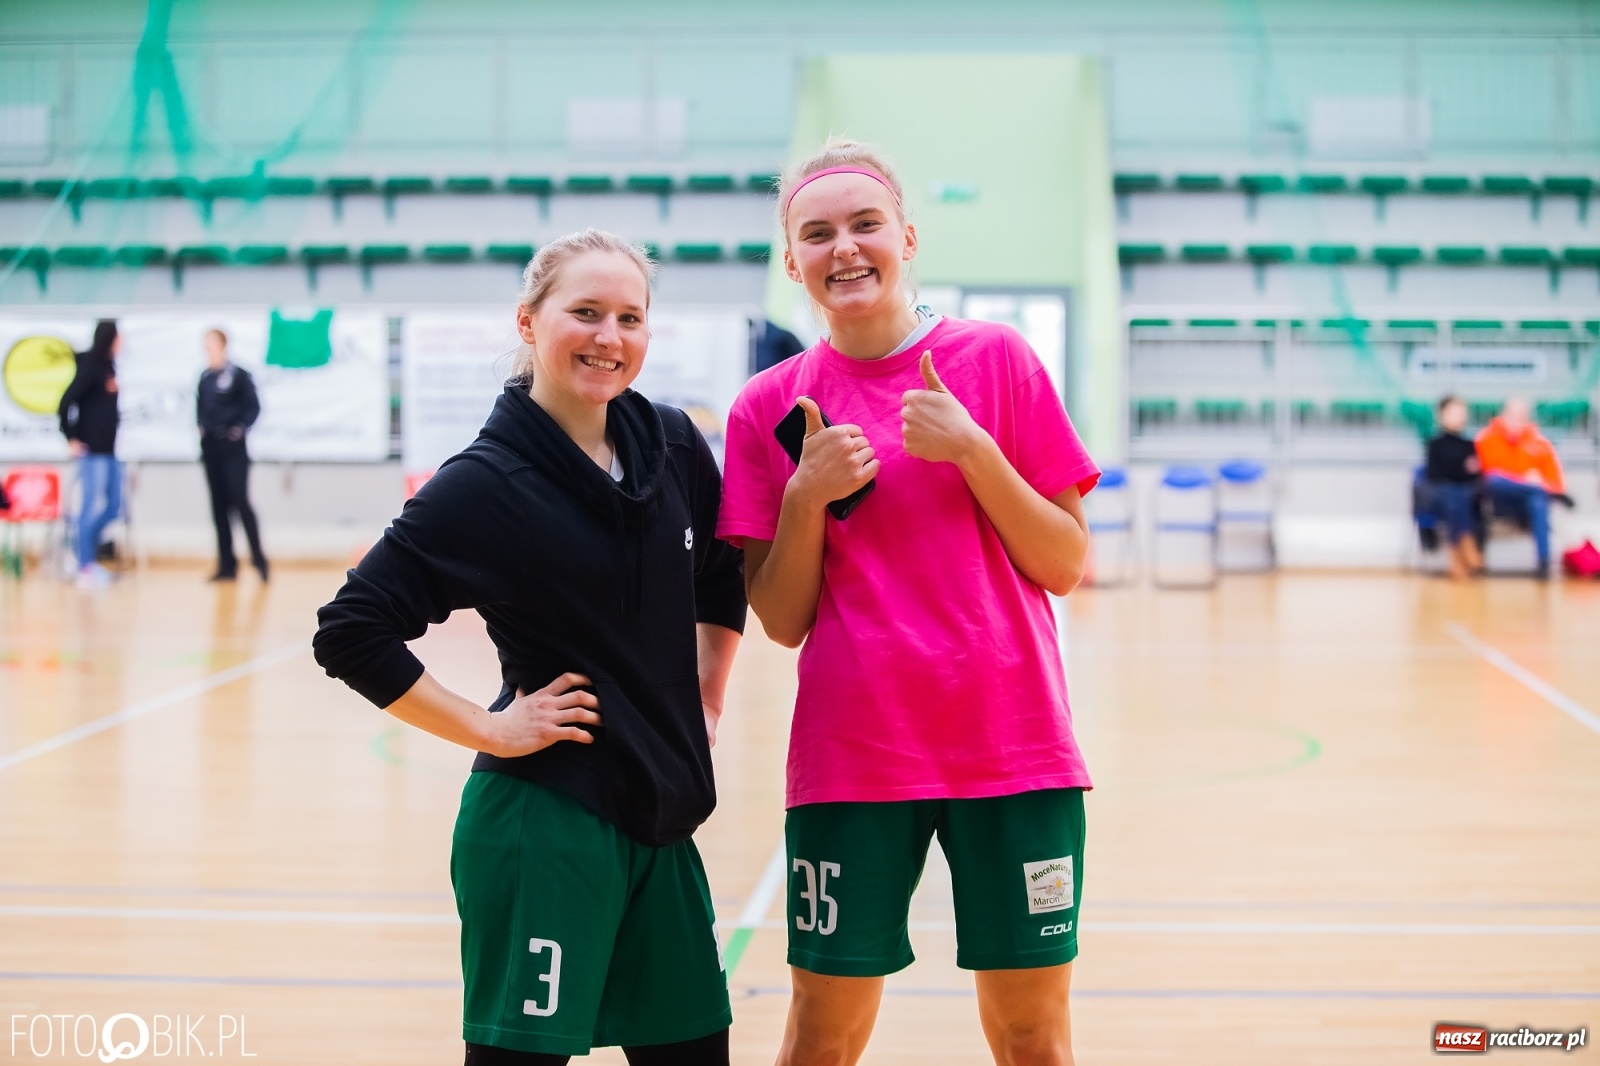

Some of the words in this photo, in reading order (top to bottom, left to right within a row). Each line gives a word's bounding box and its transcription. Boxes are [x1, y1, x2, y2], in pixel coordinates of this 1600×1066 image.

[793, 858, 841, 935] 35
[1033, 896, 1060, 906] Marcin
[523, 937, 562, 1017] 3
